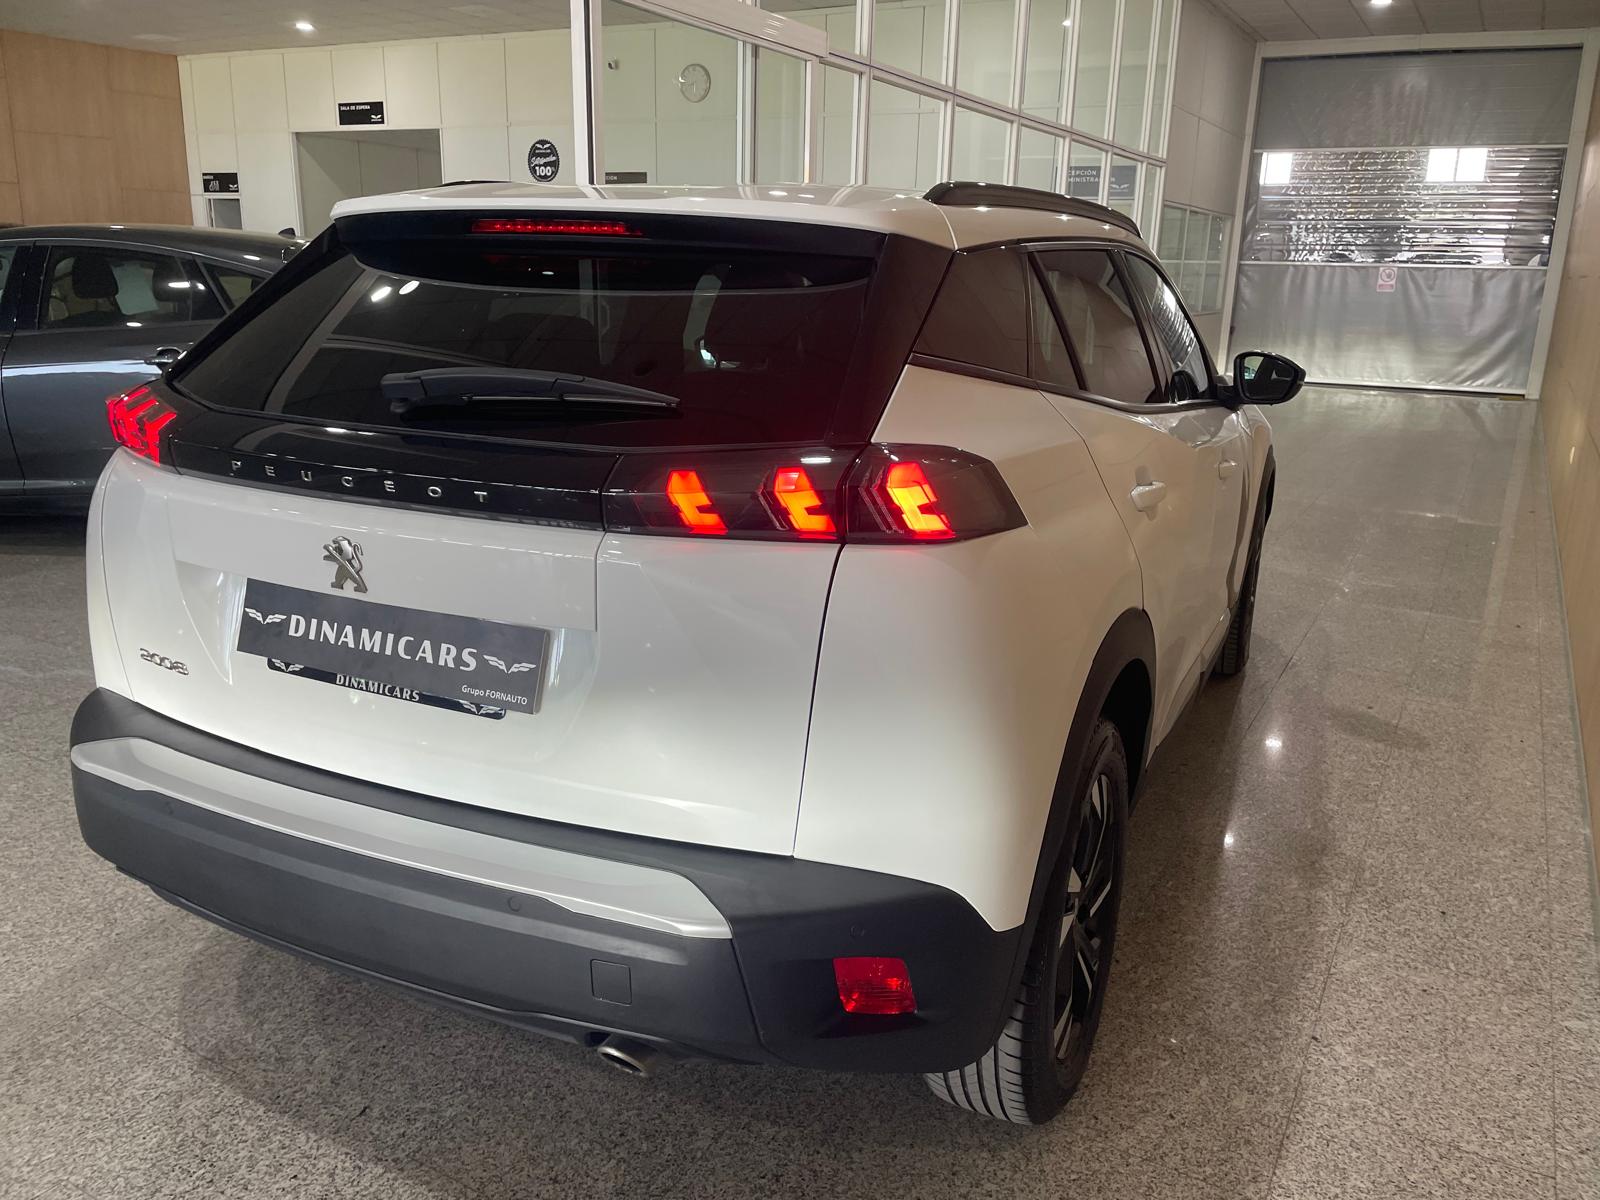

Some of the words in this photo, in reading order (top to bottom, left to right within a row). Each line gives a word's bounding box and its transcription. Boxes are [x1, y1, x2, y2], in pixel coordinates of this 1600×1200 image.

[231, 460, 488, 503] PEUGEOT
[288, 614, 478, 672] DINAMICARS
[139, 647, 190, 676] 2008
[336, 673, 420, 702] DINAMICARS
[461, 684, 485, 697] Grupo
[485, 689, 528, 705] FORNAUTO
